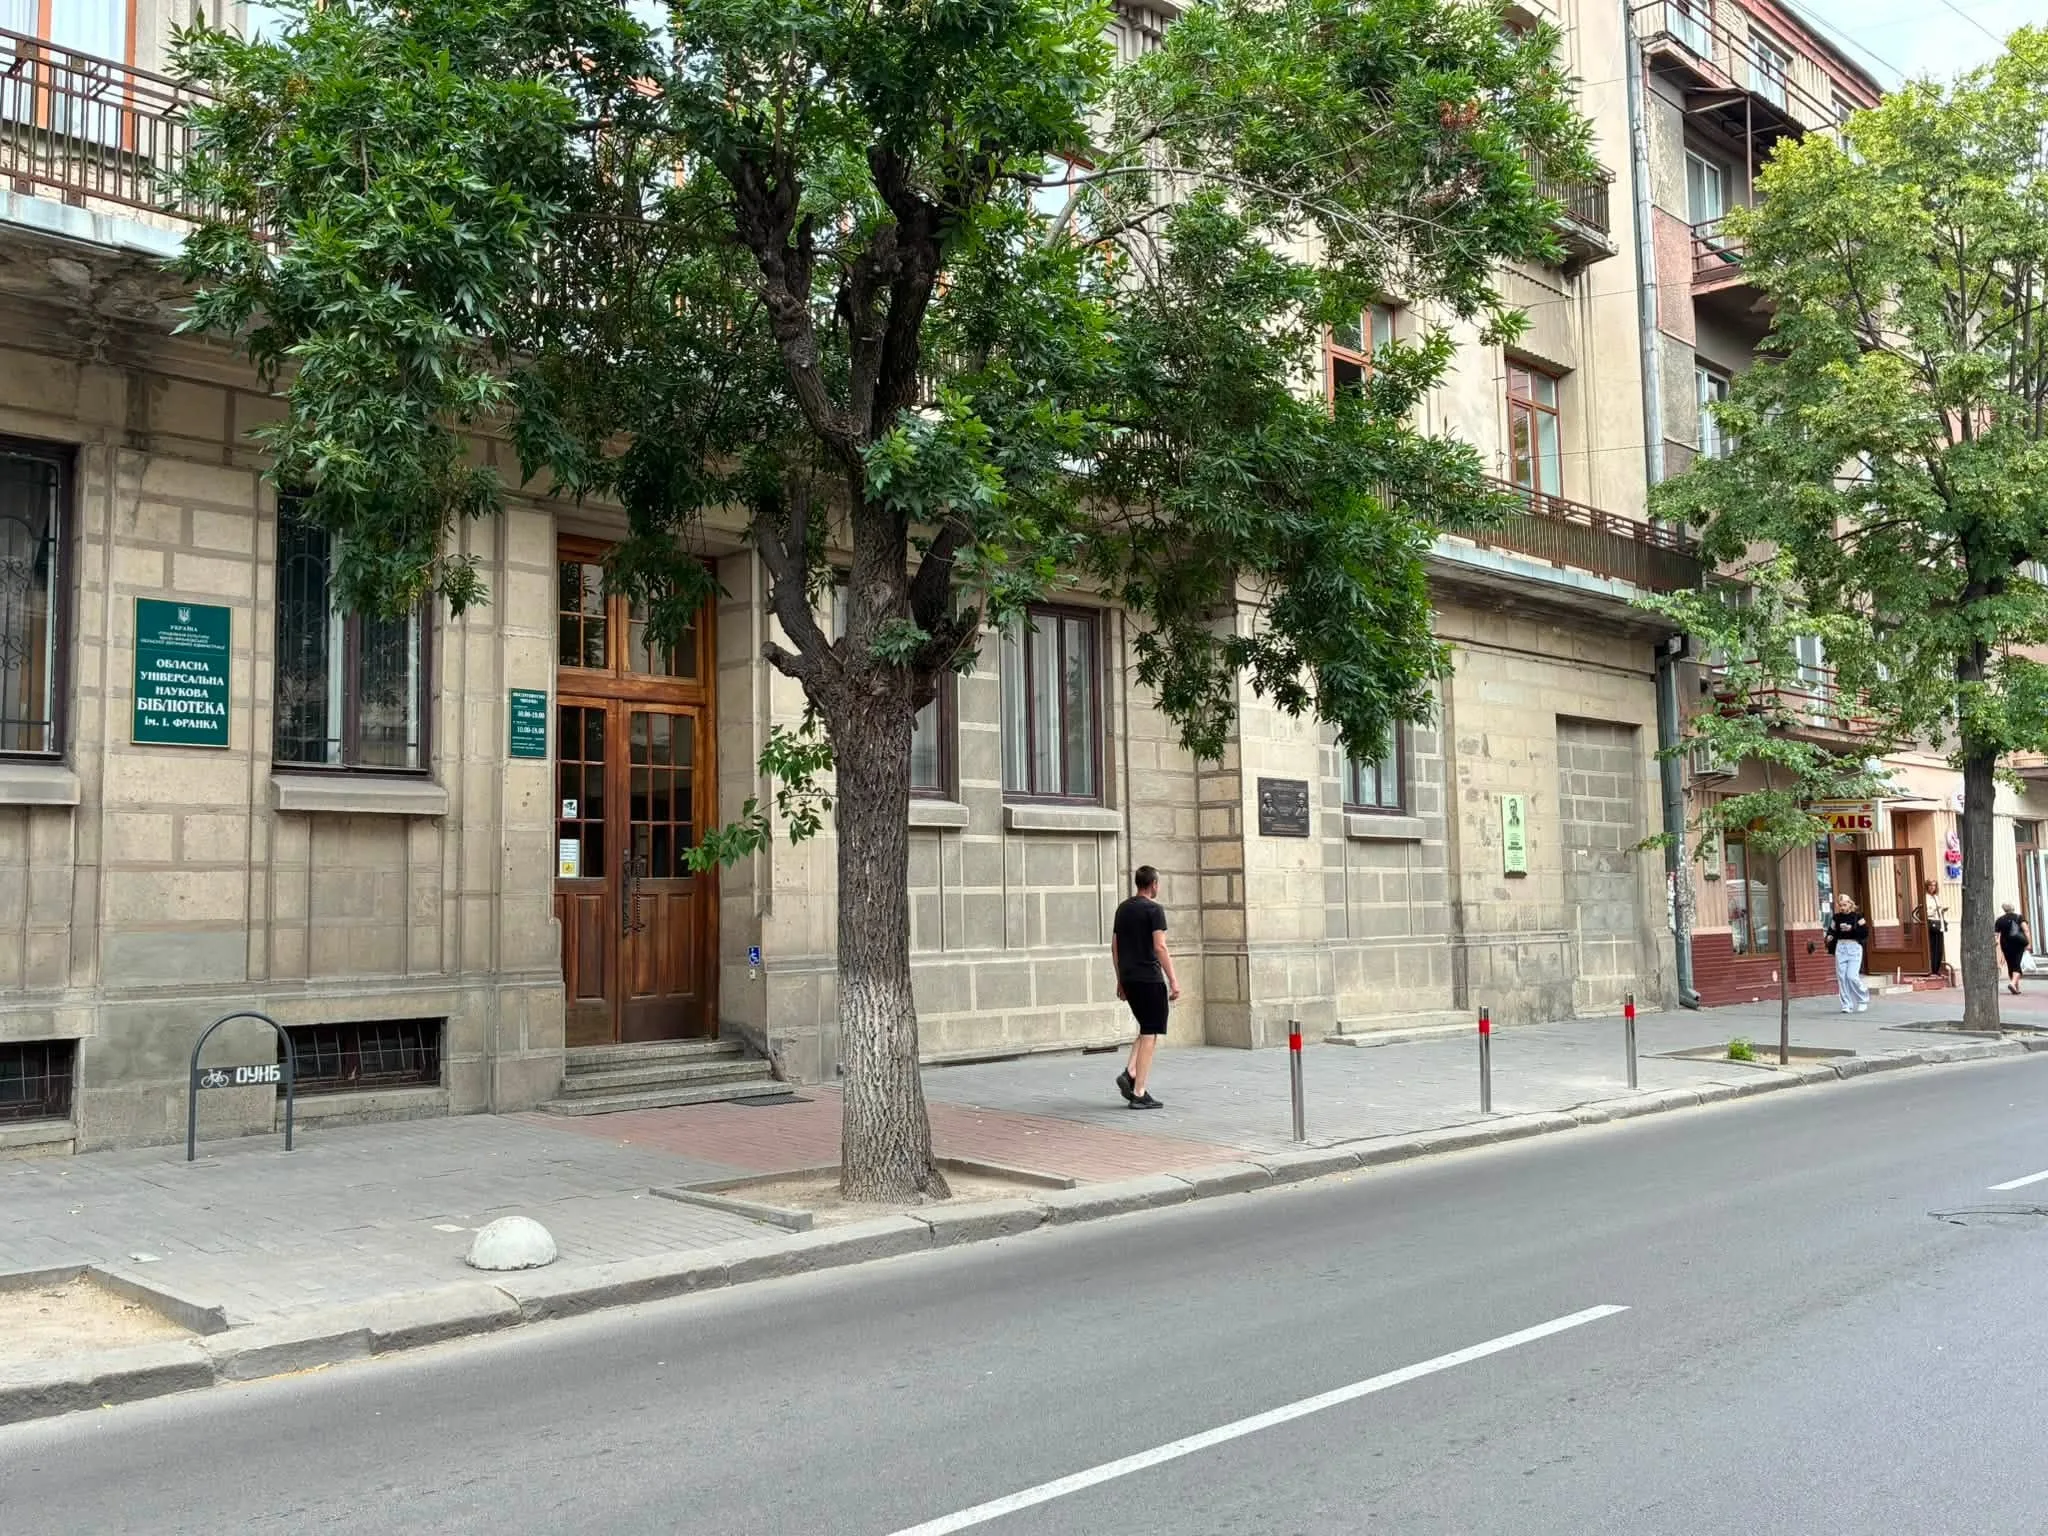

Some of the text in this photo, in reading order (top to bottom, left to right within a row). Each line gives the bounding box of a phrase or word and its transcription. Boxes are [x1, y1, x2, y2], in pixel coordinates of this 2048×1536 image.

[156, 659, 209, 671] ОБЛАСНА
[140, 671, 224, 686] УНІВЕРСАЛЬНА
[155, 686, 209, 698] НАУКОВА
[137, 697, 225, 715] БІБЛІОТЕКА
[172, 719, 218, 729] ФРАНКА
[235, 1064, 281, 1083] ОУНБ
